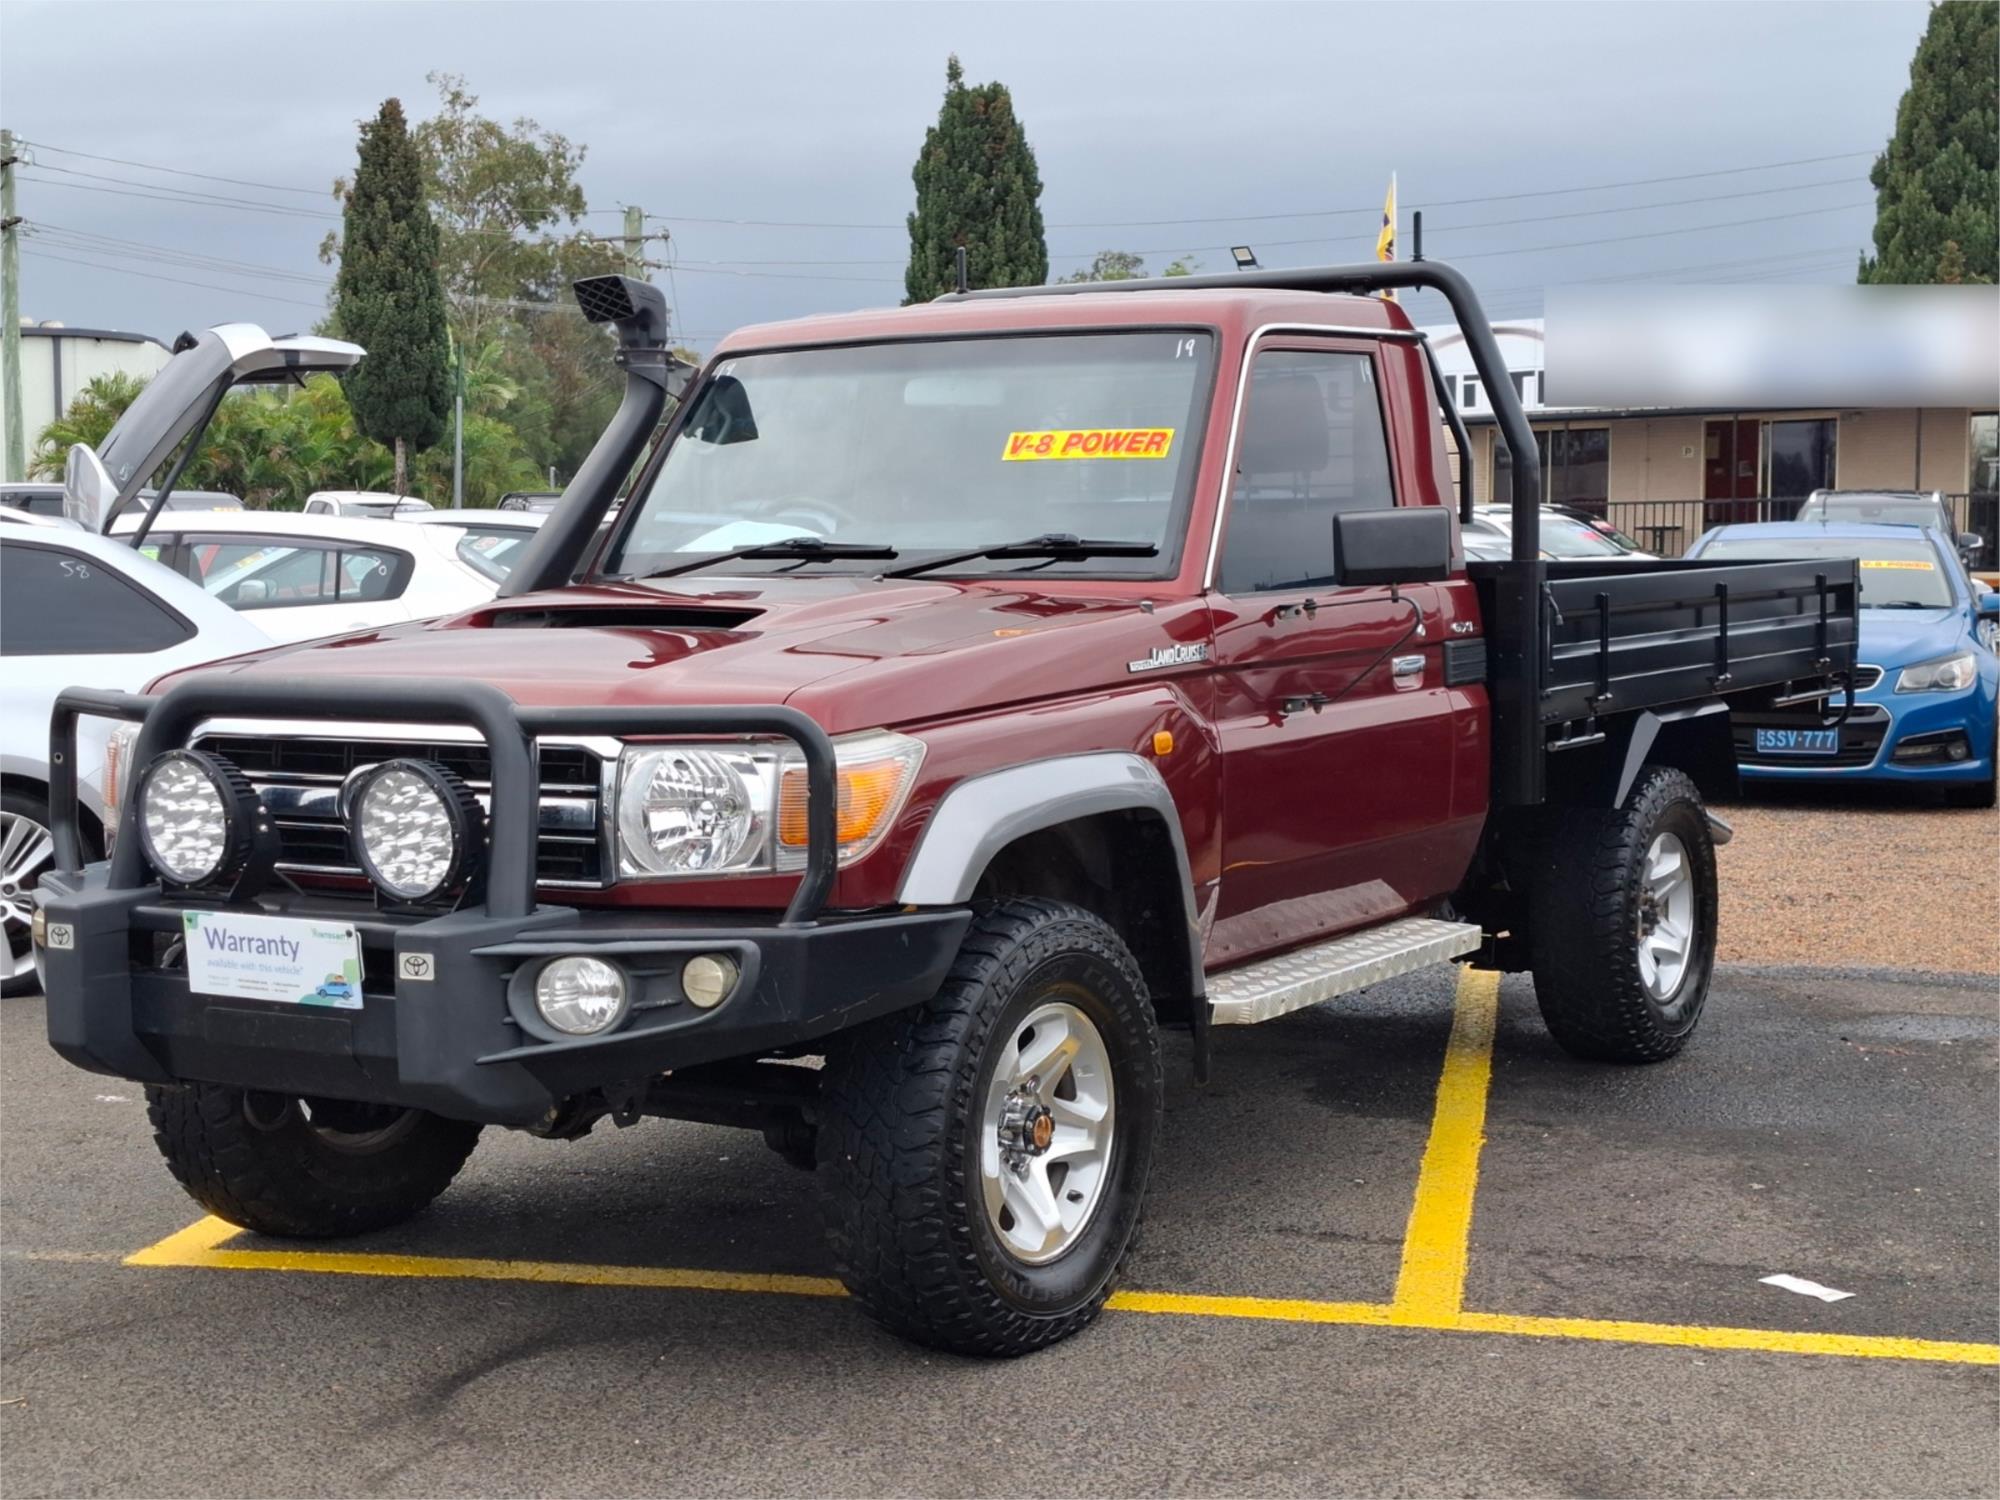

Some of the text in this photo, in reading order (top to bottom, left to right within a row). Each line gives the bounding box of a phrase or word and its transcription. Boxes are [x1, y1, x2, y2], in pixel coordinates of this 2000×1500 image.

[1176, 338, 1196, 359] 19
[1009, 431, 1169, 456] V-8 POWER
[60, 560, 90, 579] 58
[203, 926, 300, 963] Warranty
